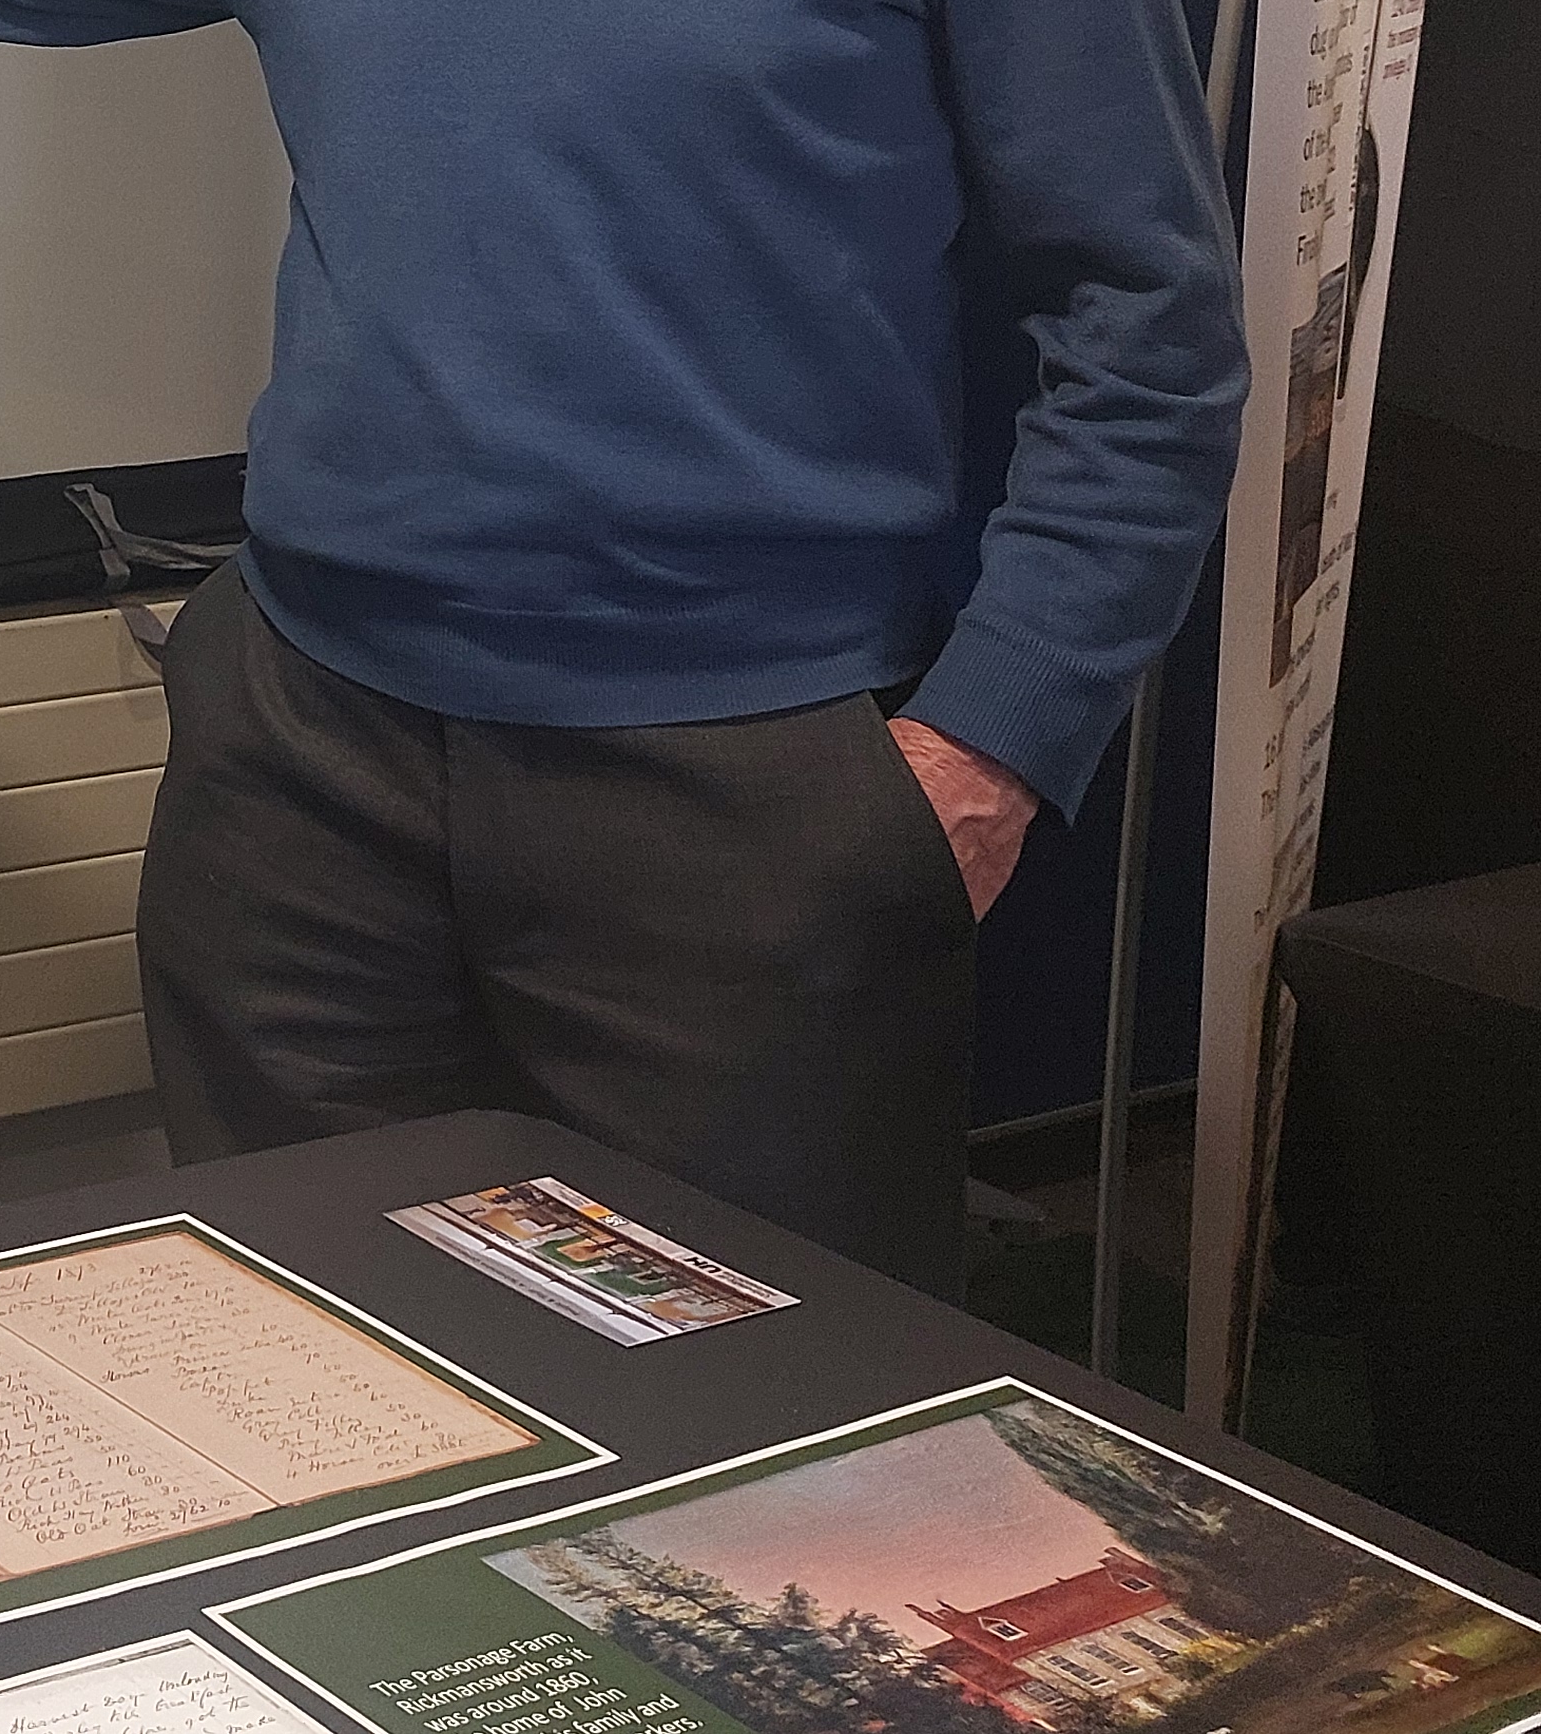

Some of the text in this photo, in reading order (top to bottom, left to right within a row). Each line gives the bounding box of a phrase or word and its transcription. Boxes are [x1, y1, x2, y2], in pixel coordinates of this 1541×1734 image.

[366, 1630, 576, 1698] The Parsonage Farm,
[393, 1645, 594, 1716] Rickmansworth as it
[421, 1669, 600, 1734] was around 1860,
[545, 1698, 575, 1721] of
[570, 1686, 629, 1712] John
[634, 1690, 681, 1718] and
